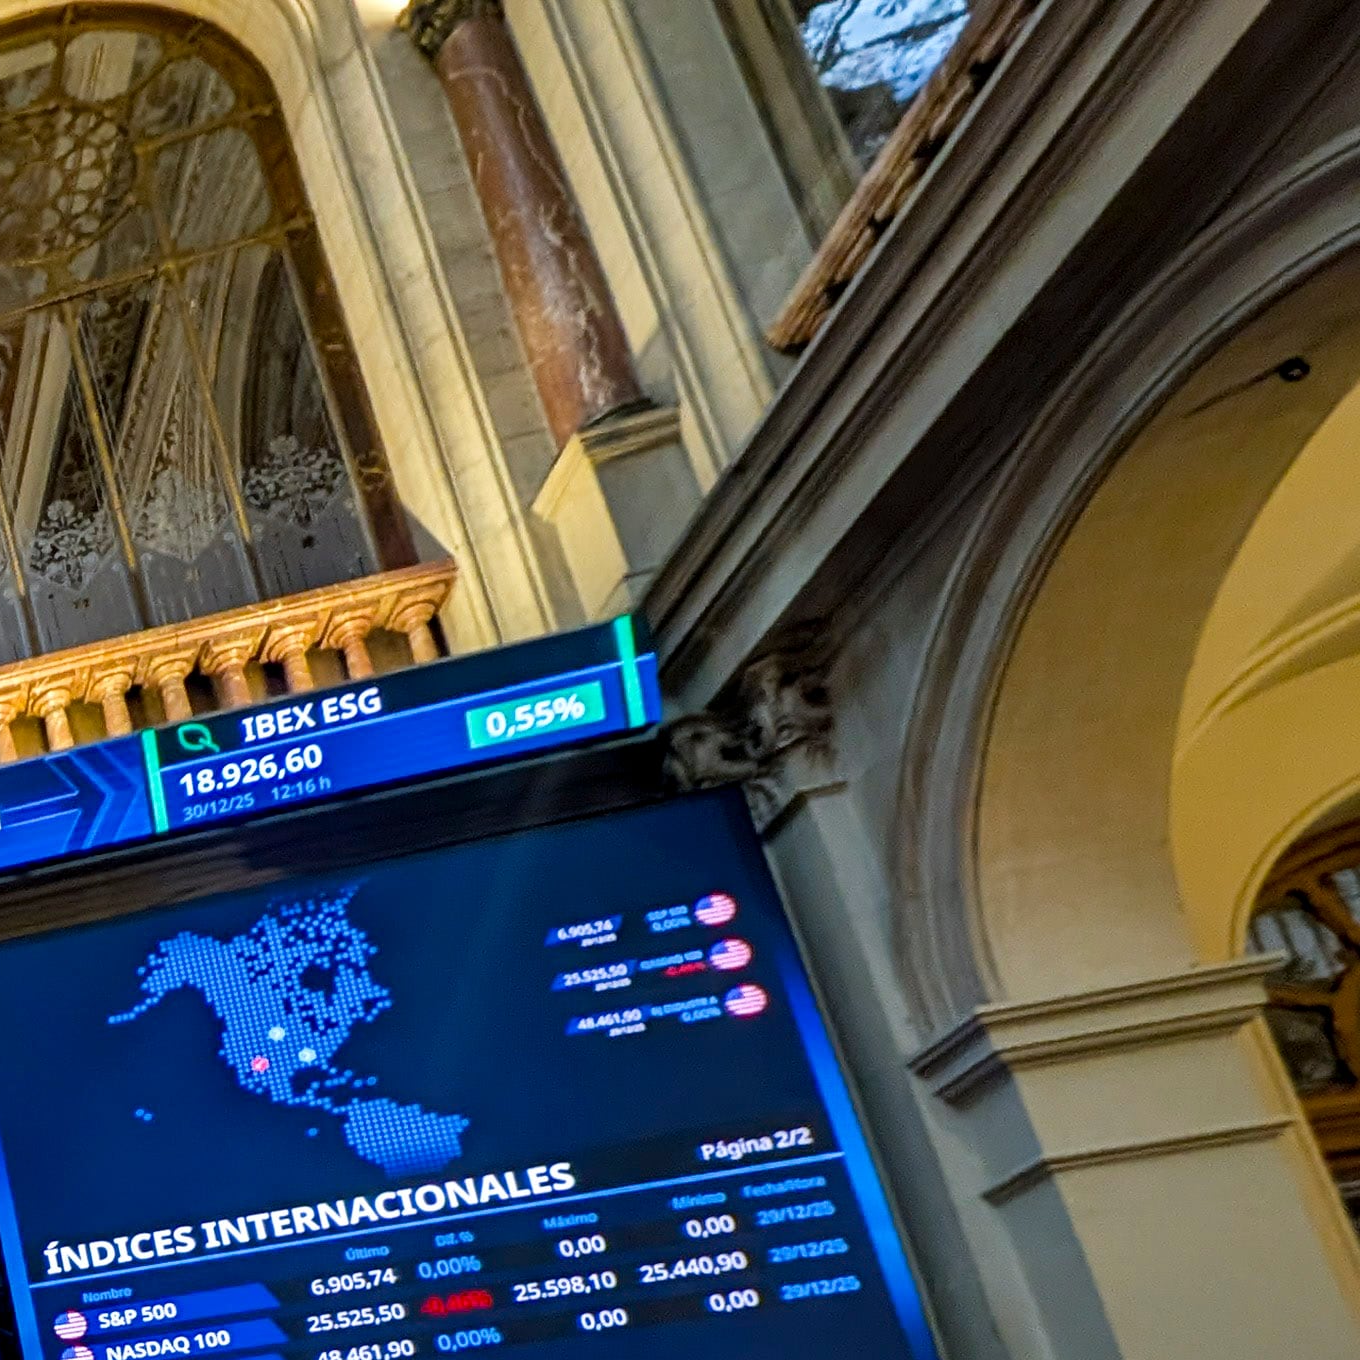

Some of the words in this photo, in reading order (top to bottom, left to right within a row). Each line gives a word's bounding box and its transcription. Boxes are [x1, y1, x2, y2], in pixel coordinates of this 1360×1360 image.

[242, 702, 316, 745] IBEX
[322, 687, 382, 729] ESG
[486, 693, 585, 738] 0,55%
[180, 744, 323, 798] 18.926,60
[182, 793, 255, 823] 30/12/25
[271, 779, 317, 802] 12:16
[700, 1132, 774, 1163] Página
[774, 1126, 814, 1149] 2/2
[43, 1224, 196, 1275] ÍNDICES
[204, 1161, 576, 1249] INTERNACIONALES
[82, 1286, 132, 1303] Nombre
[345, 1244, 390, 1262] Último
[543, 1211, 599, 1231] Máximo
[98, 1307, 137, 1329] S&P
[141, 1302, 178, 1323] 500
[310, 1268, 397, 1298] 6.905,74
[417, 1256, 482, 1281] 0,00%
[558, 1234, 607, 1259] 0,00
[685, 1215, 736, 1239] 0,00
[194, 1330, 231, 1350] 100
[307, 1303, 406, 1334] 25.525,50
[513, 1270, 618, 1302] 25.598,10
[638, 1251, 748, 1285] 25.440,90
[437, 1328, 501, 1353] 0,00%
[580, 1307, 628, 1331] 0,00
[709, 1288, 760, 1313] 0,00
